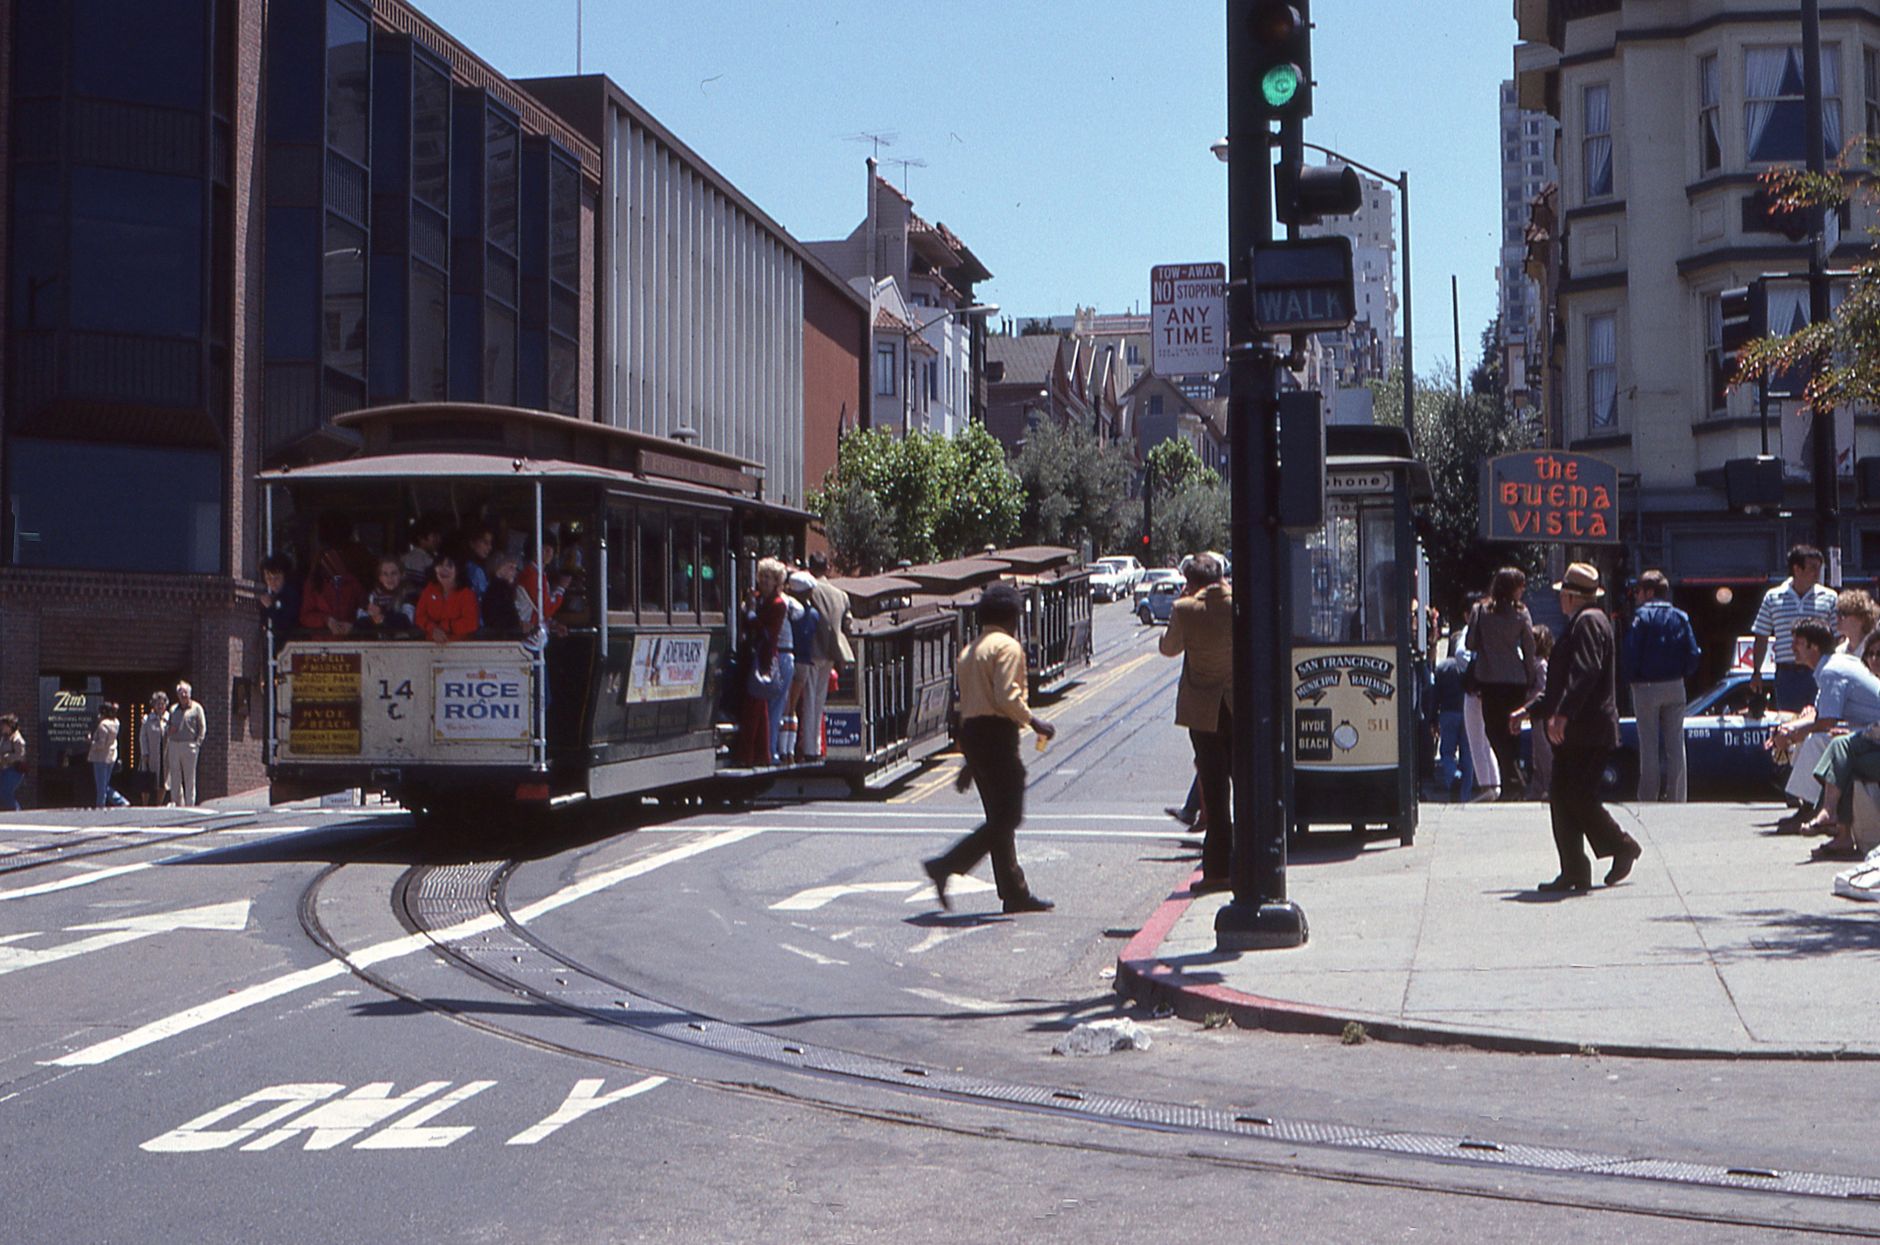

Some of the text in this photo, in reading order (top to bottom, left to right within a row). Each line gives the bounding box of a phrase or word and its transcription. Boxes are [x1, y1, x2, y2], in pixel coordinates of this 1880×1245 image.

[1159, 265, 1219, 280] TOW-AWAY
[1153, 281, 1223, 302] NO STOPPING
[1260, 287, 1345, 322] WALK
[1167, 306, 1210, 324] ANY
[1164, 326, 1213, 345] TIME
[310, 663, 352, 672] MARKET
[1297, 656, 1389, 675] SAN FRANCISCO
[378, 680, 414, 700] 14
[444, 682, 520, 698] RICE
[1296, 674, 1392, 696] MUNICIPAL RAILWAY
[303, 709, 345, 718] HYDE
[309, 719, 351, 728] BEACH
[1301, 719, 1326, 732] HYDE
[1367, 718, 1390, 732] 511
[1298, 736, 1329, 750] BEACH
[139, 1076, 669, 1152] ONLY
